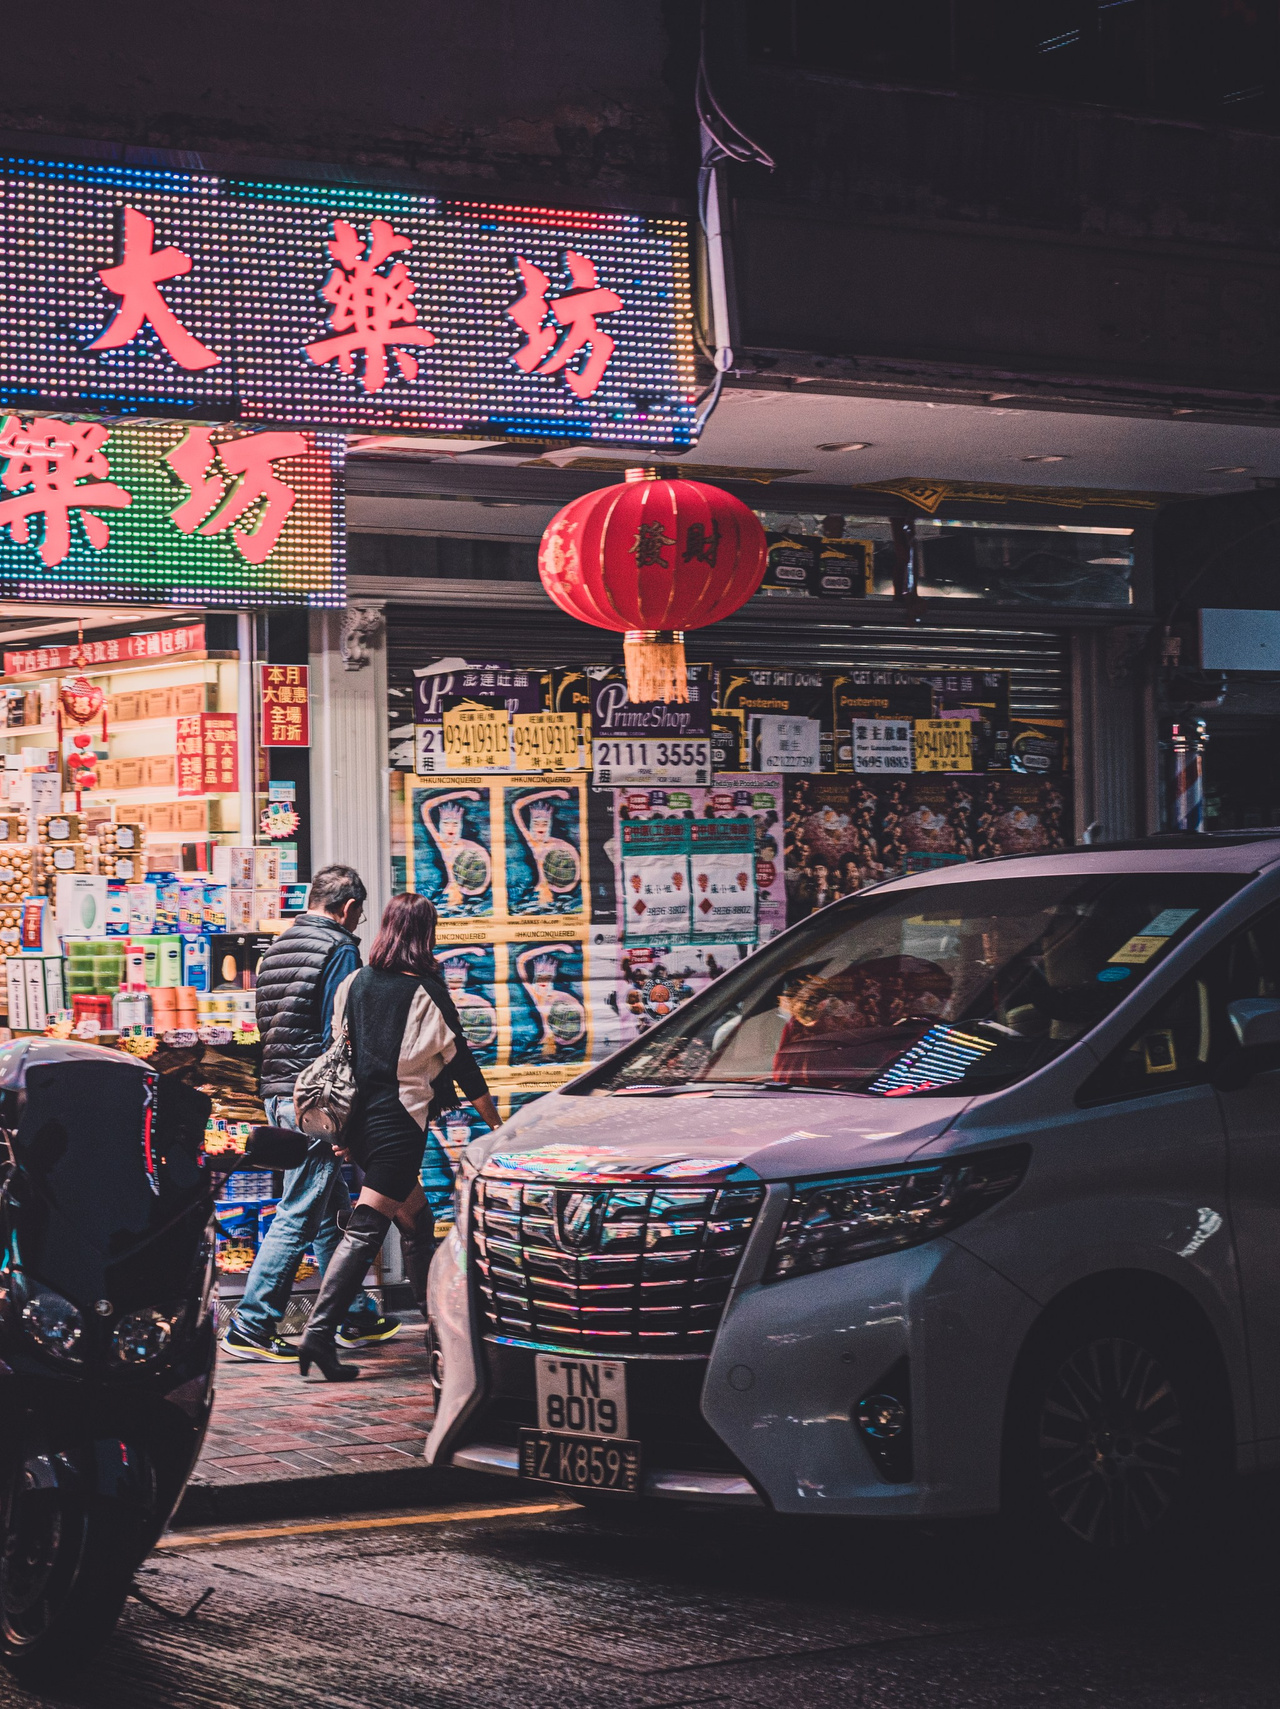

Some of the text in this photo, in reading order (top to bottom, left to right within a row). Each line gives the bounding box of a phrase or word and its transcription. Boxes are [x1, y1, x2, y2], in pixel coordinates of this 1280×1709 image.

[267, 666, 301, 685] 本月
[262, 686, 308, 704] 大優惠
[738, 696, 790, 711] Postering
[839, 695, 890, 709] Postering
[270, 705, 303, 724] 全場
[596, 682, 692, 735] PrimeShop
[271, 724, 303, 742] 打折
[446, 723, 508, 755] 93419313
[514, 724, 577, 756] 93419313
[598, 743, 647, 766] 2111
[656, 743, 706, 766] 3555
[560, 1361, 601, 1399] TN
[547, 1394, 619, 1434] 8019
